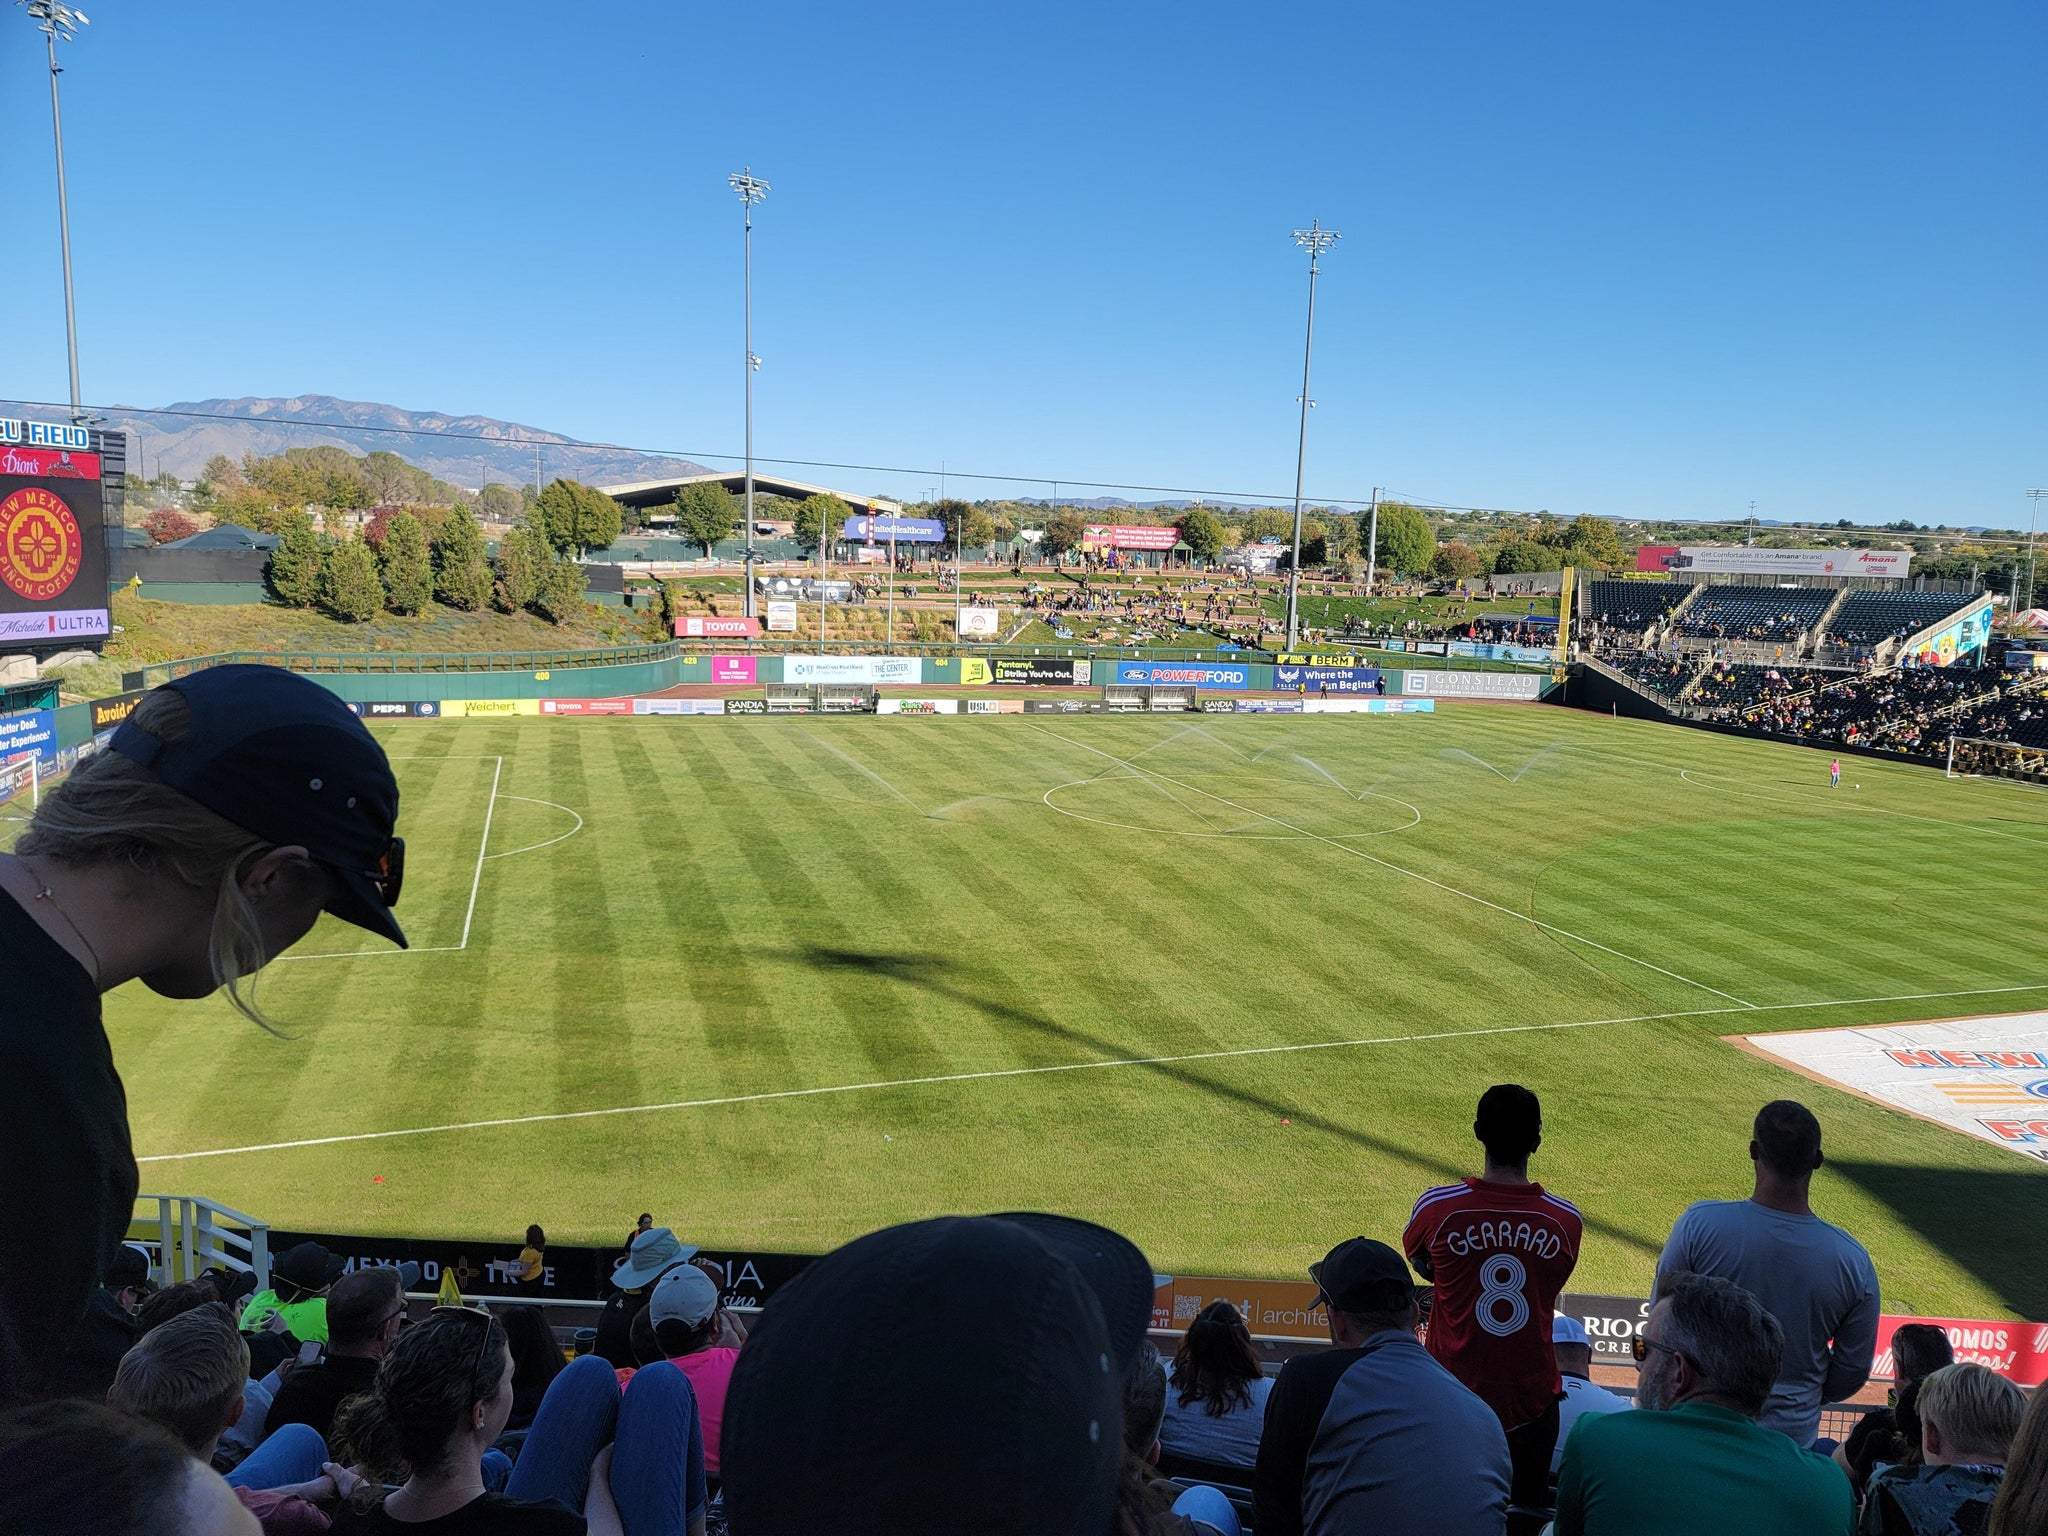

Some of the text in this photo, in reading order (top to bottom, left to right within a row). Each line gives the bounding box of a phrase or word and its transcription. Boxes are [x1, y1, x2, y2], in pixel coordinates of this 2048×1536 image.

[28, 421, 88, 449] FIELD
[2, 448, 40, 475] Dion's
[0, 491, 75, 533] NEW MEXICO
[874, 525, 933, 535] nitedHealthcare
[1859, 553, 1897, 563] Amana
[0, 556, 77, 595] PIÑON COFFEE
[0, 616, 104, 634] Michelob ULTRA
[705, 622, 747, 632] TOYOTA
[935, 659, 949, 667] 404
[1316, 656, 1349, 666] BERM
[874, 663, 909, 673] THE CENTER
[534, 672, 550, 681] 400
[1004, 670, 1028, 678] Strike
[1029, 670, 1054, 678] You're
[1055, 670, 1073, 678] Out.
[1305, 670, 1353, 680] Where the
[1435, 673, 1533, 687] GONSTEAD
[1320, 680, 1375, 691] Fun Begins!
[372, 704, 406, 714] PEPSI
[465, 702, 516, 712] Weichert
[727, 701, 764, 709] SANDIA
[900, 700, 923, 709] Clark's
[97, 701, 127, 724] Avoid
[20, 718, 38, 730] Deal.
[1882, 1049, 2048, 1069] NEW
[1447, 1220, 1560, 1259] GERRARD
[485, 1263, 555, 1286] TRE
[1475, 1253, 1530, 1337] 8
[1160, 1319, 1170, 1328] IT
[1583, 1316, 1633, 1338] RIO
